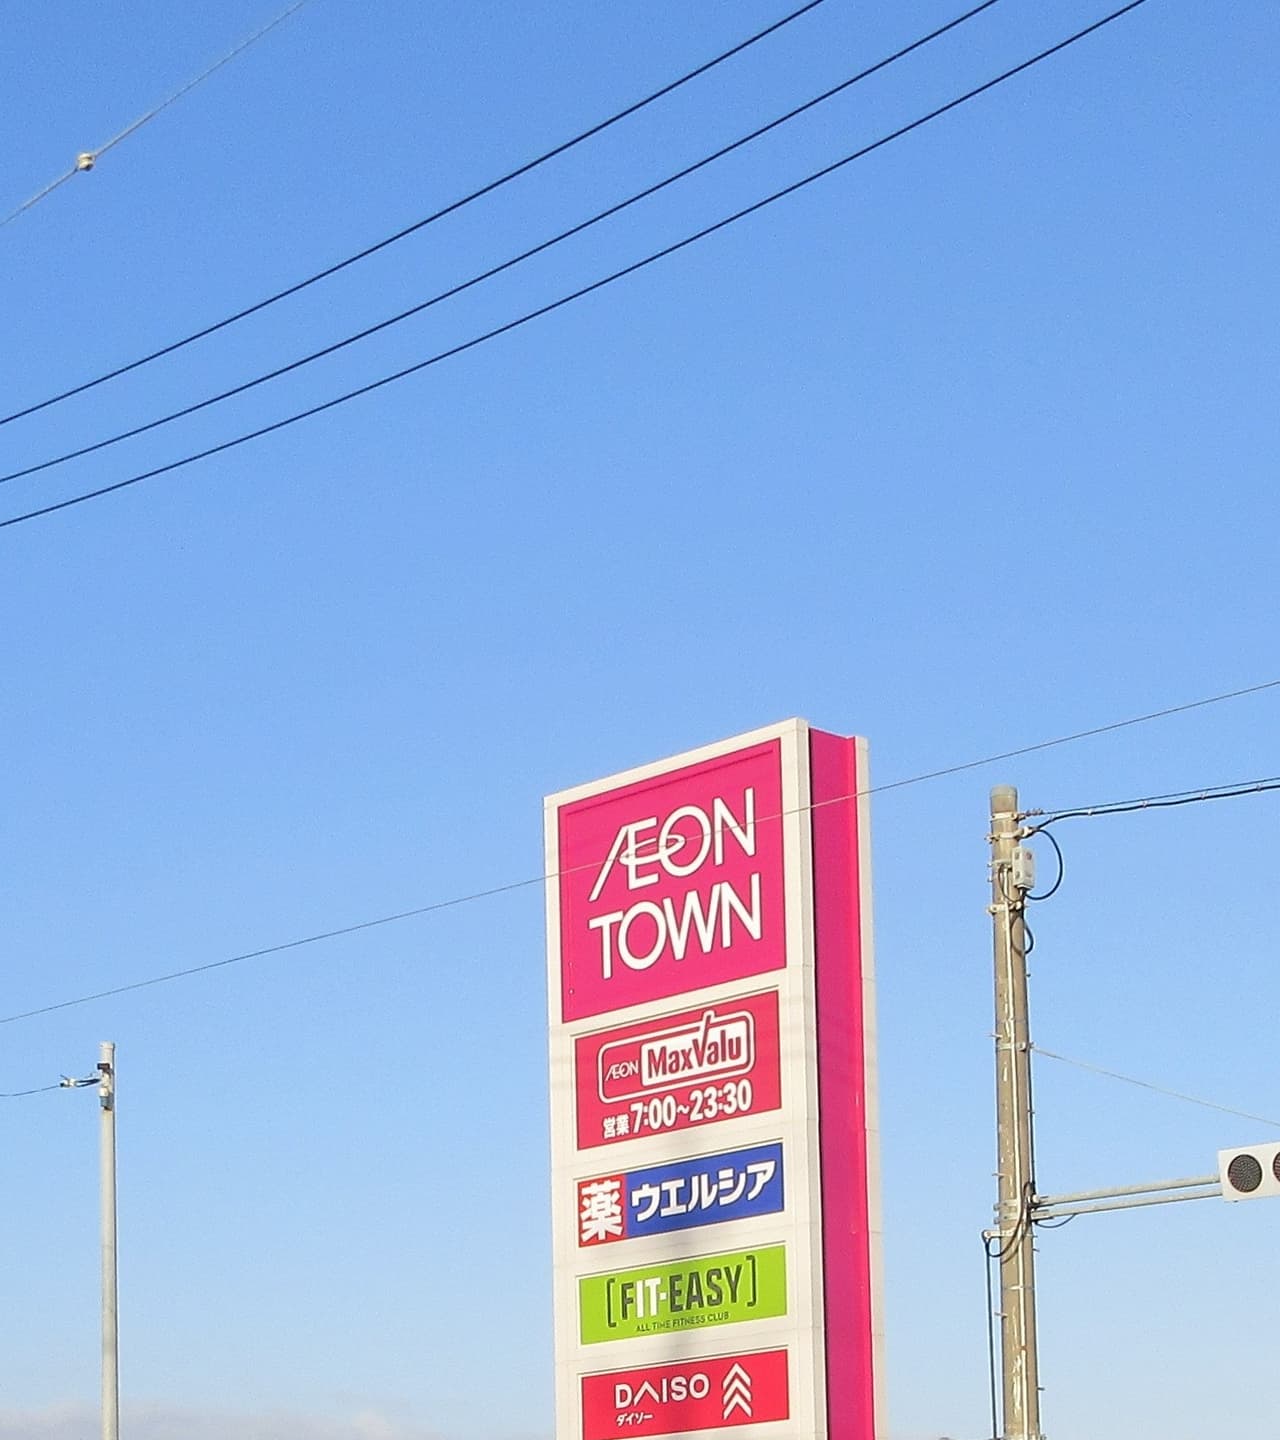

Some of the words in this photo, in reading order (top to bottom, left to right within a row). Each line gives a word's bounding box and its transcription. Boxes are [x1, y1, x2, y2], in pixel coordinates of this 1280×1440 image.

[588, 872, 763, 979] TOWN
[647, 1014, 741, 1079] MaxValu
[603, 1113, 629, 1139] 営業
[581, 1179, 623, 1242] 薬
[631, 1160, 776, 1222] ウエルシア
[636, 1322, 650, 1332] ALL
[653, 1320, 671, 1330] TIME
[672, 1315, 706, 1327] FITNESS
[708, 1311, 729, 1322] CLUB
[615, 1373, 710, 1409] DAISO
[616, 1412, 653, 1426] ダイソー
